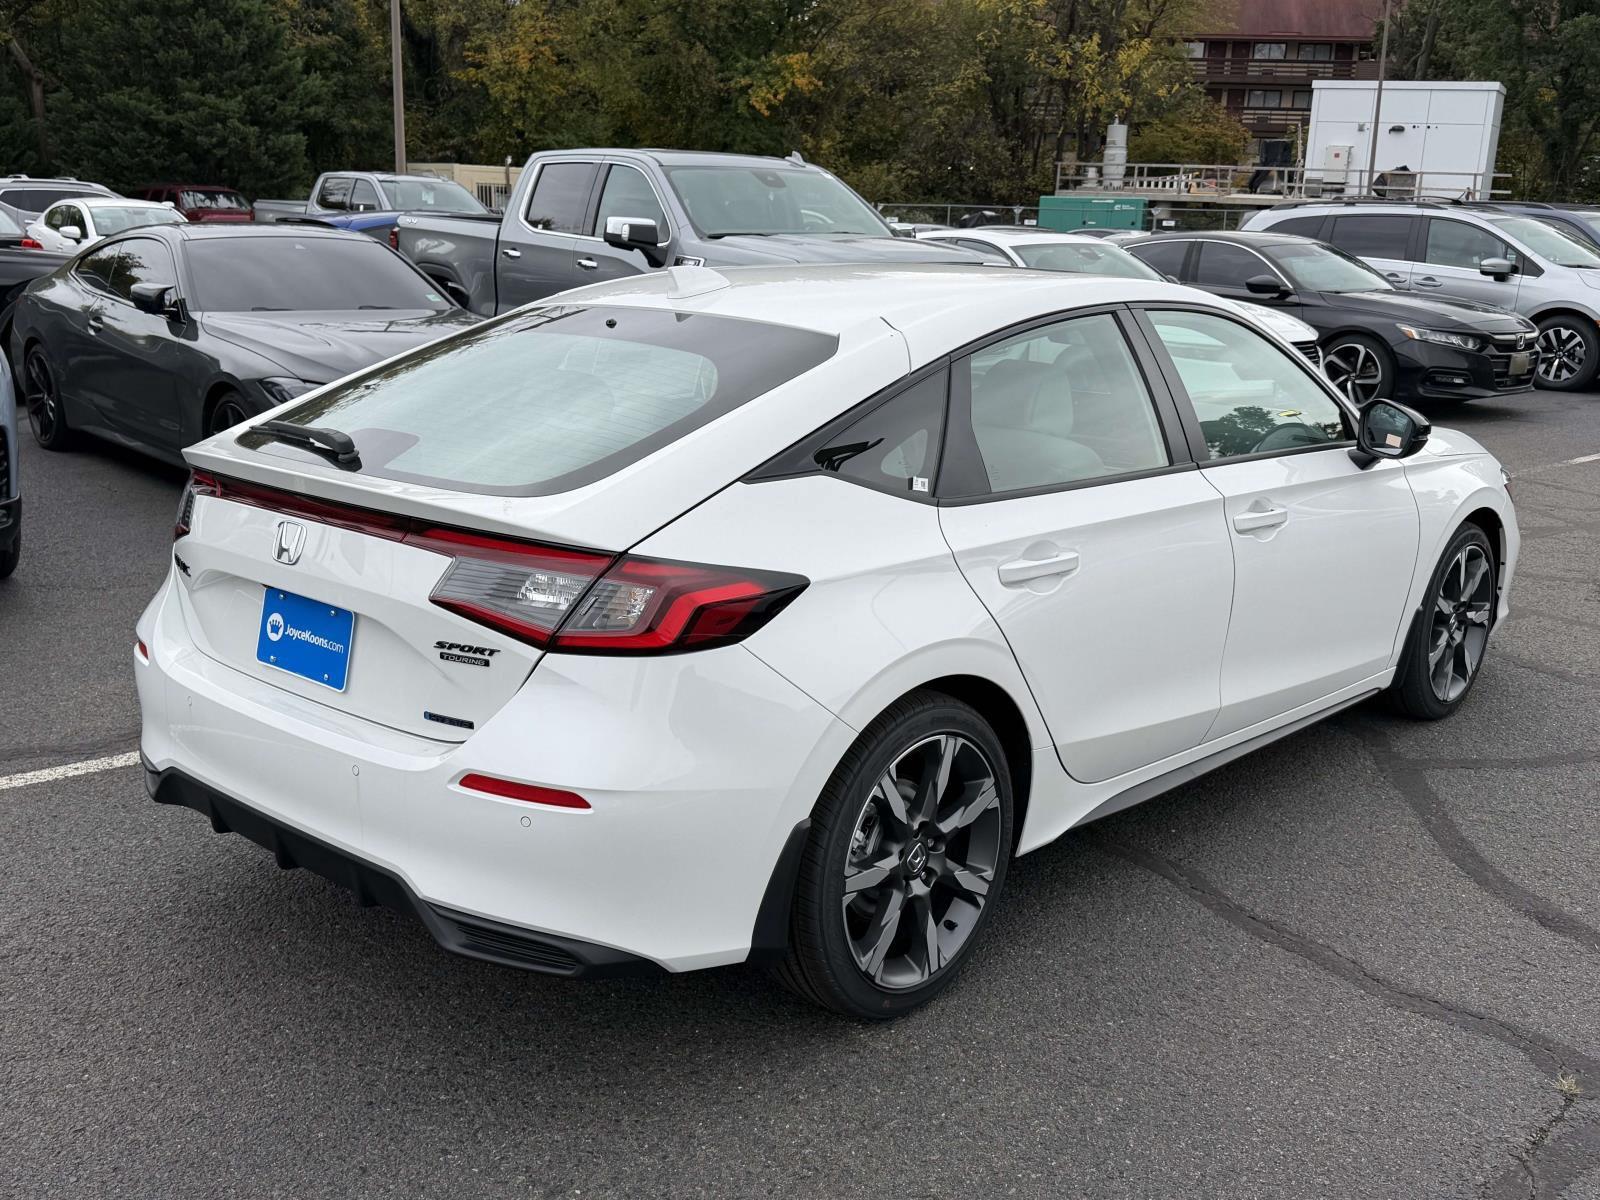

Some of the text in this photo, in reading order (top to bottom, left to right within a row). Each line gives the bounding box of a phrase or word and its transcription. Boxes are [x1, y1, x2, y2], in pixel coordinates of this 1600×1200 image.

[285, 624, 344, 654] JoyceKoons.com
[433, 640, 501, 657] SPORT
[442, 653, 486, 666] TOURING
